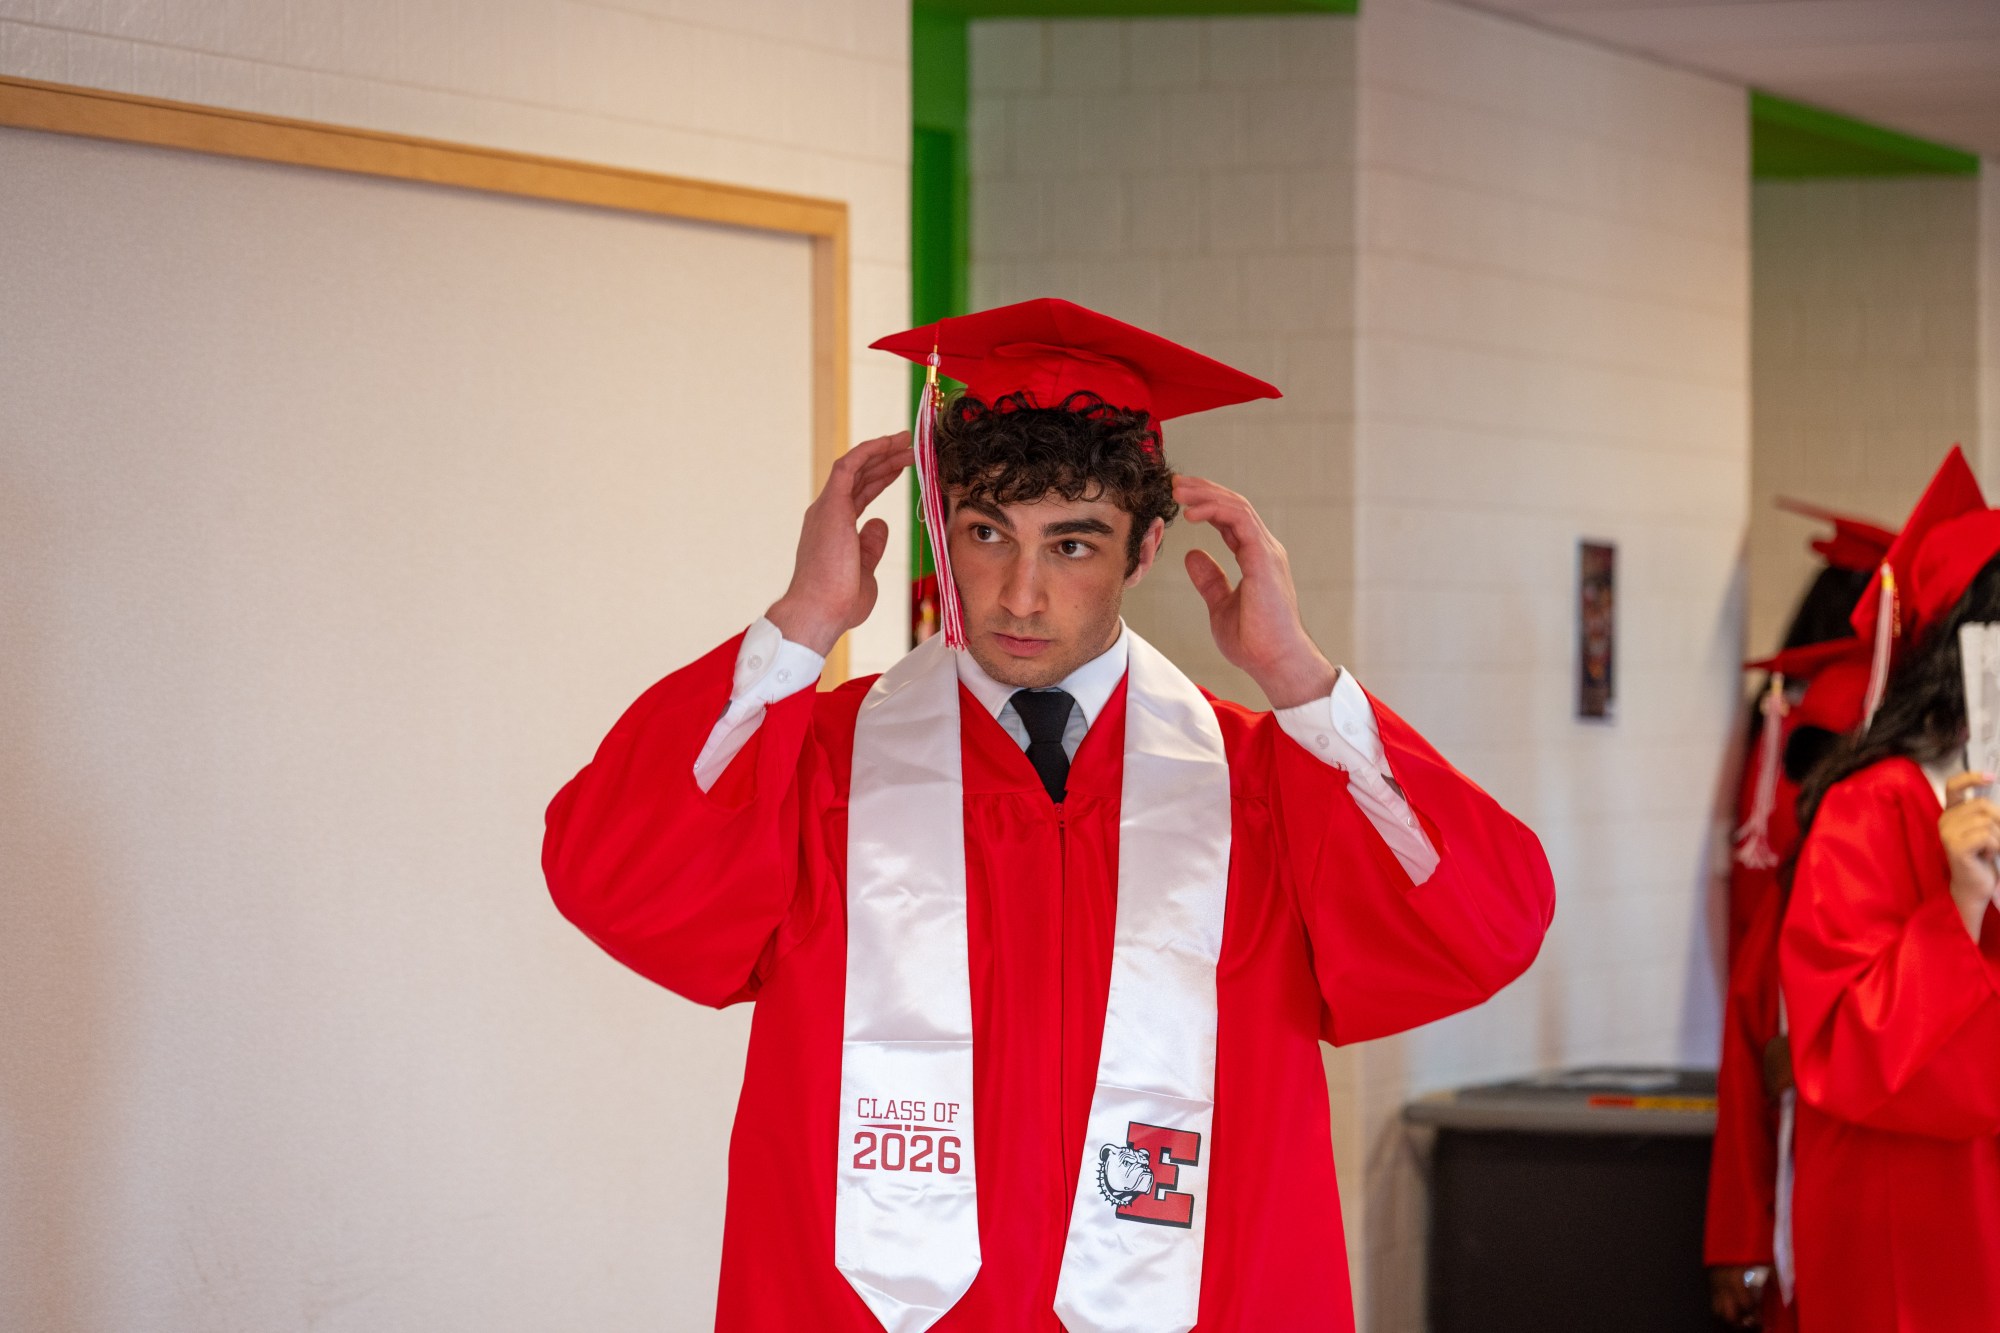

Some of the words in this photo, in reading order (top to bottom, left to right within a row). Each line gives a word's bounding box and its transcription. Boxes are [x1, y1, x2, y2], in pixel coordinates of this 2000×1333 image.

[857, 1097, 926, 1122] CLASS
[933, 1102, 960, 1123] OF
[852, 1131, 962, 1175] 2026
[1115, 1120, 1202, 1230] E
